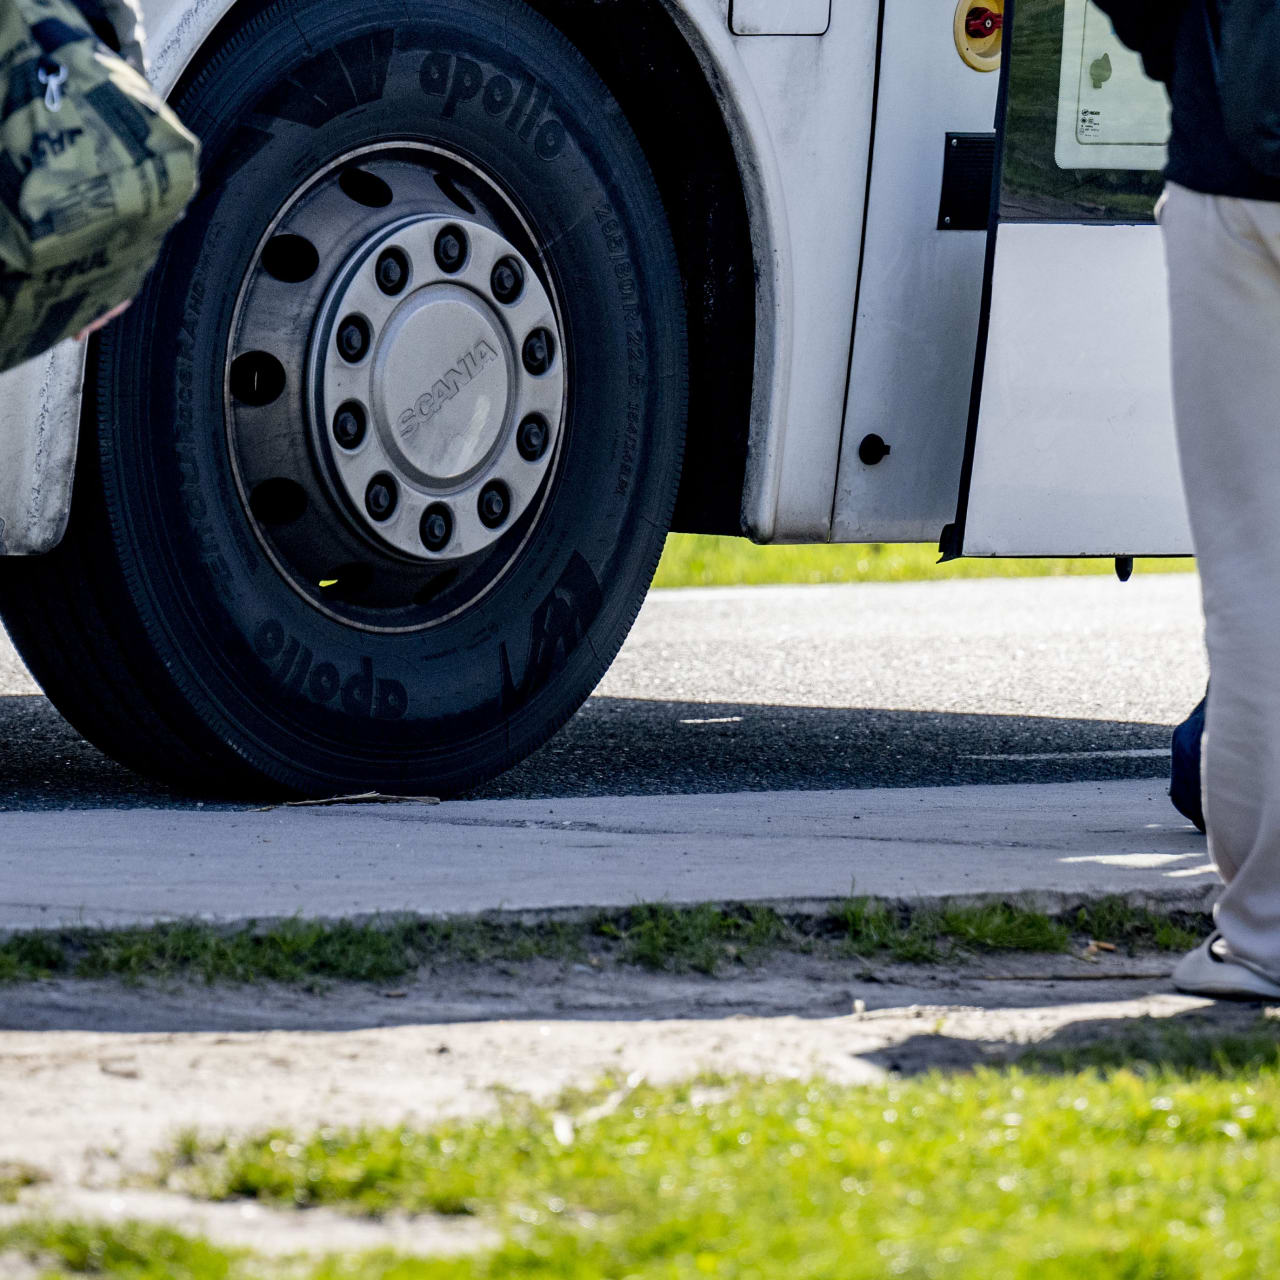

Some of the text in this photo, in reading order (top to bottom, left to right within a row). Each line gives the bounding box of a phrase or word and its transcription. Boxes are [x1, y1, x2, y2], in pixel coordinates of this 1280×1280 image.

[419, 51, 566, 161] apollo
[396, 336, 499, 441] SCANIA
[254, 619, 409, 719] apollo
